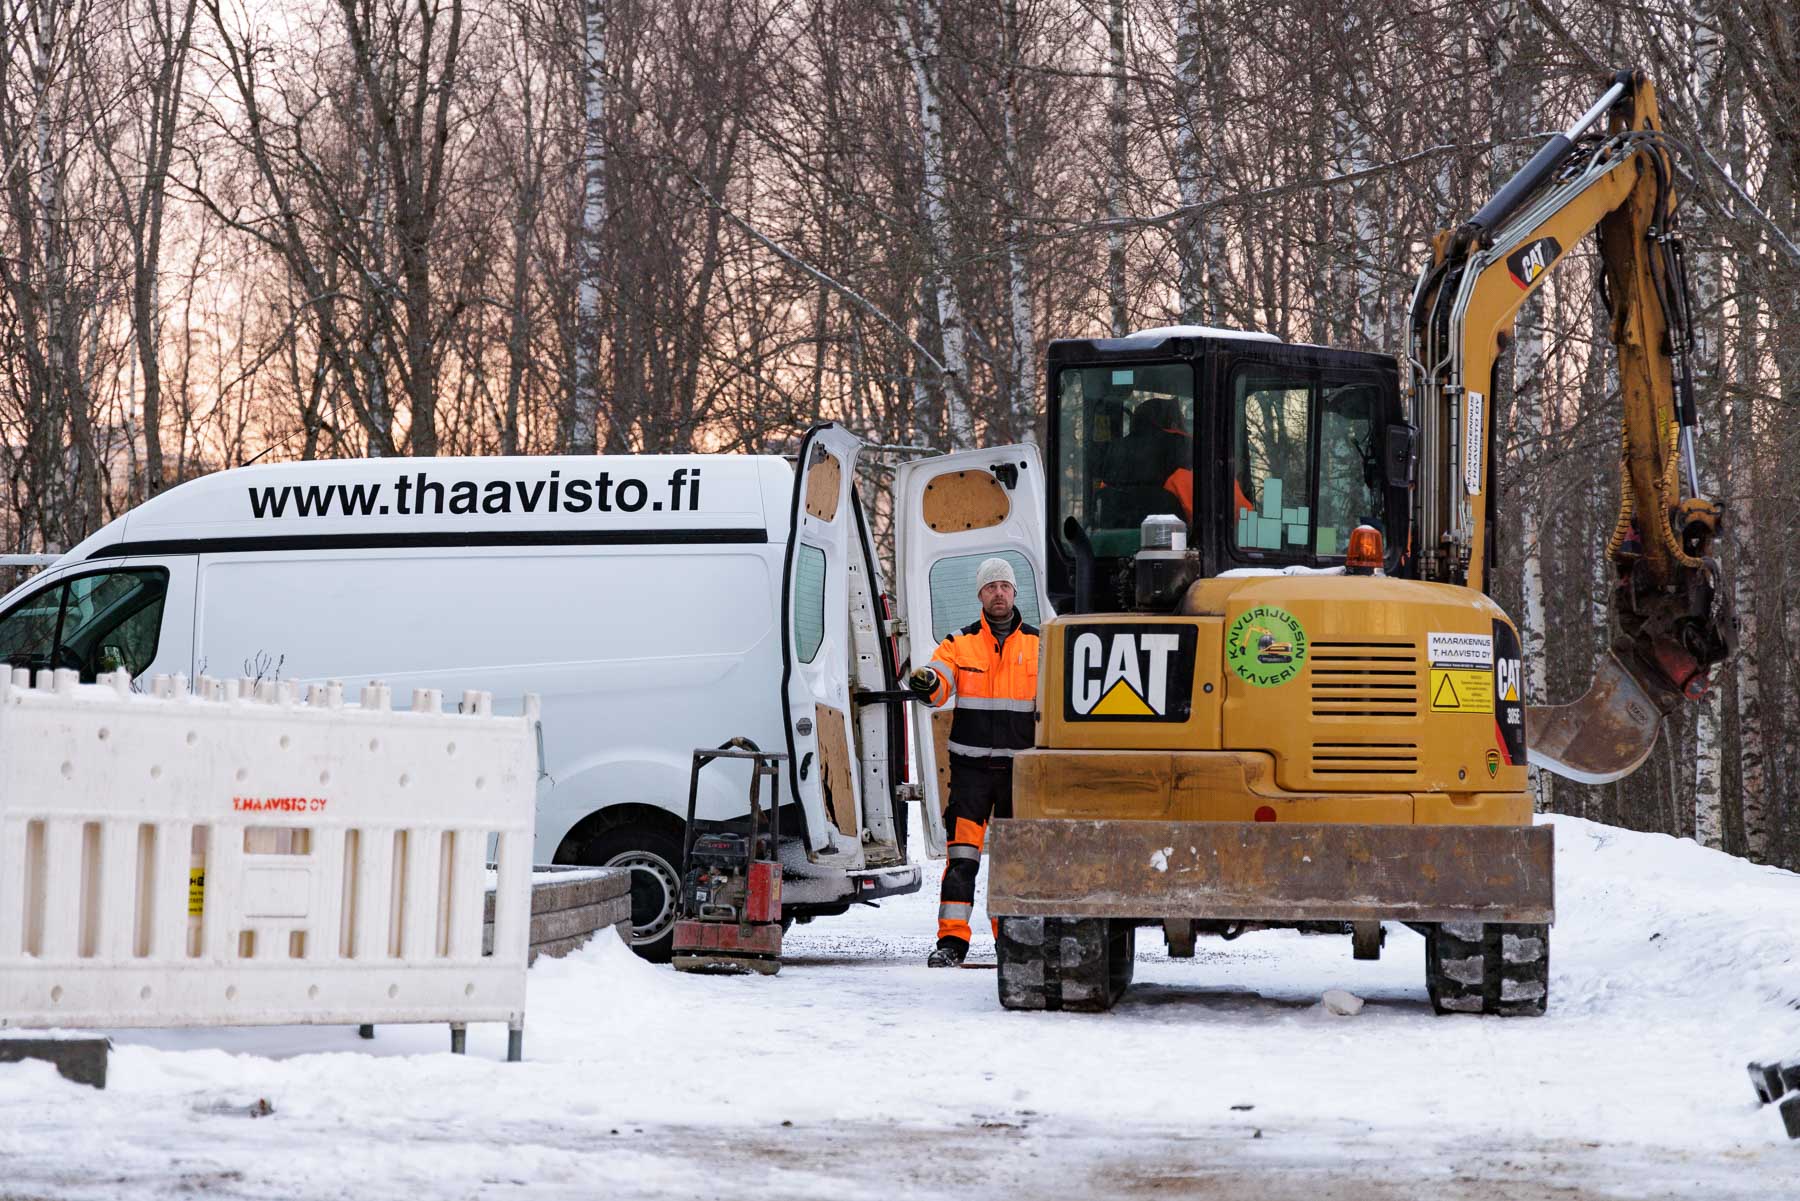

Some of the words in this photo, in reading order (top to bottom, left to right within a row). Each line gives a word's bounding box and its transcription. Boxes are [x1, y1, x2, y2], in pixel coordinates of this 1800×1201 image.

[1522, 241, 1546, 283] CAT
[248, 468, 701, 518] www.thaavisto.fi
[1228, 608, 1305, 660] KAIVURIJUSSIN
[1433, 637, 1490, 647] MAARAKENNUS
[1441, 649, 1480, 658] HAAVISTO
[1482, 651, 1490, 659] OY
[1072, 632, 1180, 715] CAT
[1237, 665, 1297, 685] KAVERI
[1498, 657, 1521, 701] CAT
